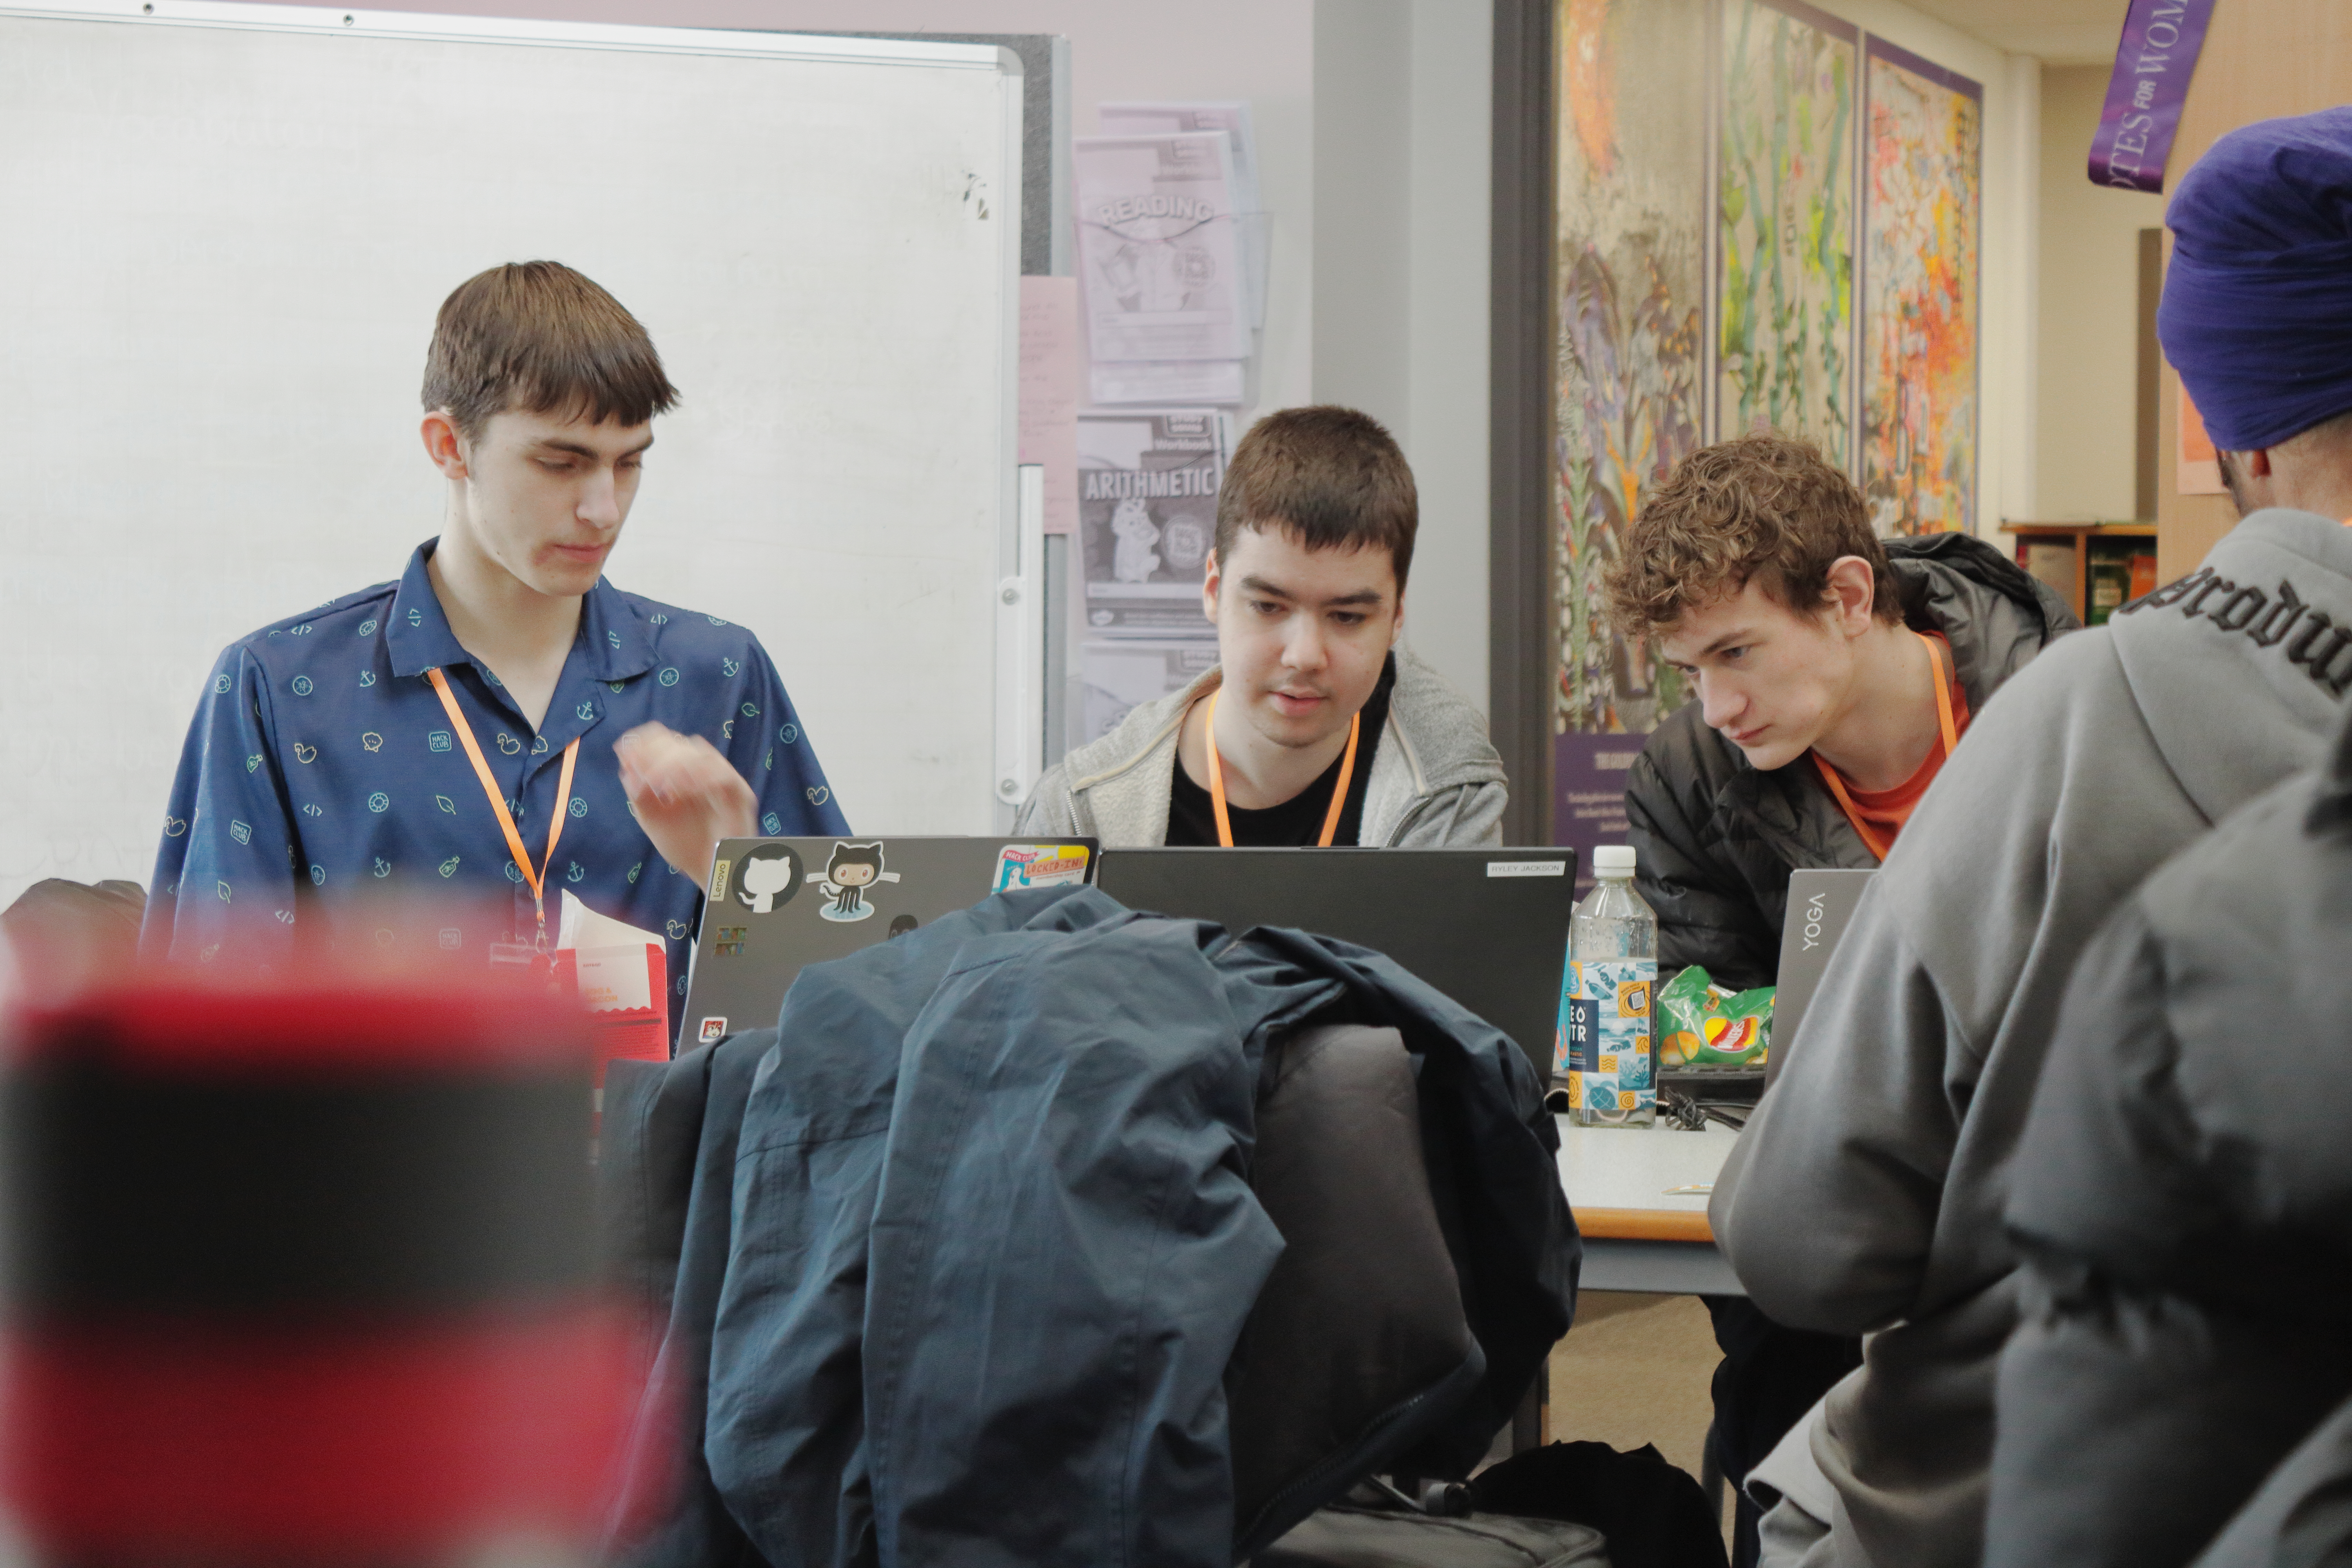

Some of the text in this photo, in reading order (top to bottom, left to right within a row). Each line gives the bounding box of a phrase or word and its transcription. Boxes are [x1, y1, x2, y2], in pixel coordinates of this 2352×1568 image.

[2133, 80, 2156, 109] FOR
[1099, 196, 1214, 225] READING
[1154, 438, 1212, 450] Workbook
[1085, 468, 1214, 500] ARITHMETIC
[233, 829, 246, 841] CLUB
[234, 824, 247, 835] HACK
[1023, 853, 1035, 861] CLUB
[713, 864, 726, 897] Lenovo
[1802, 893, 1826, 951] YOGA
[1570, 1024, 1586, 1042] TR
